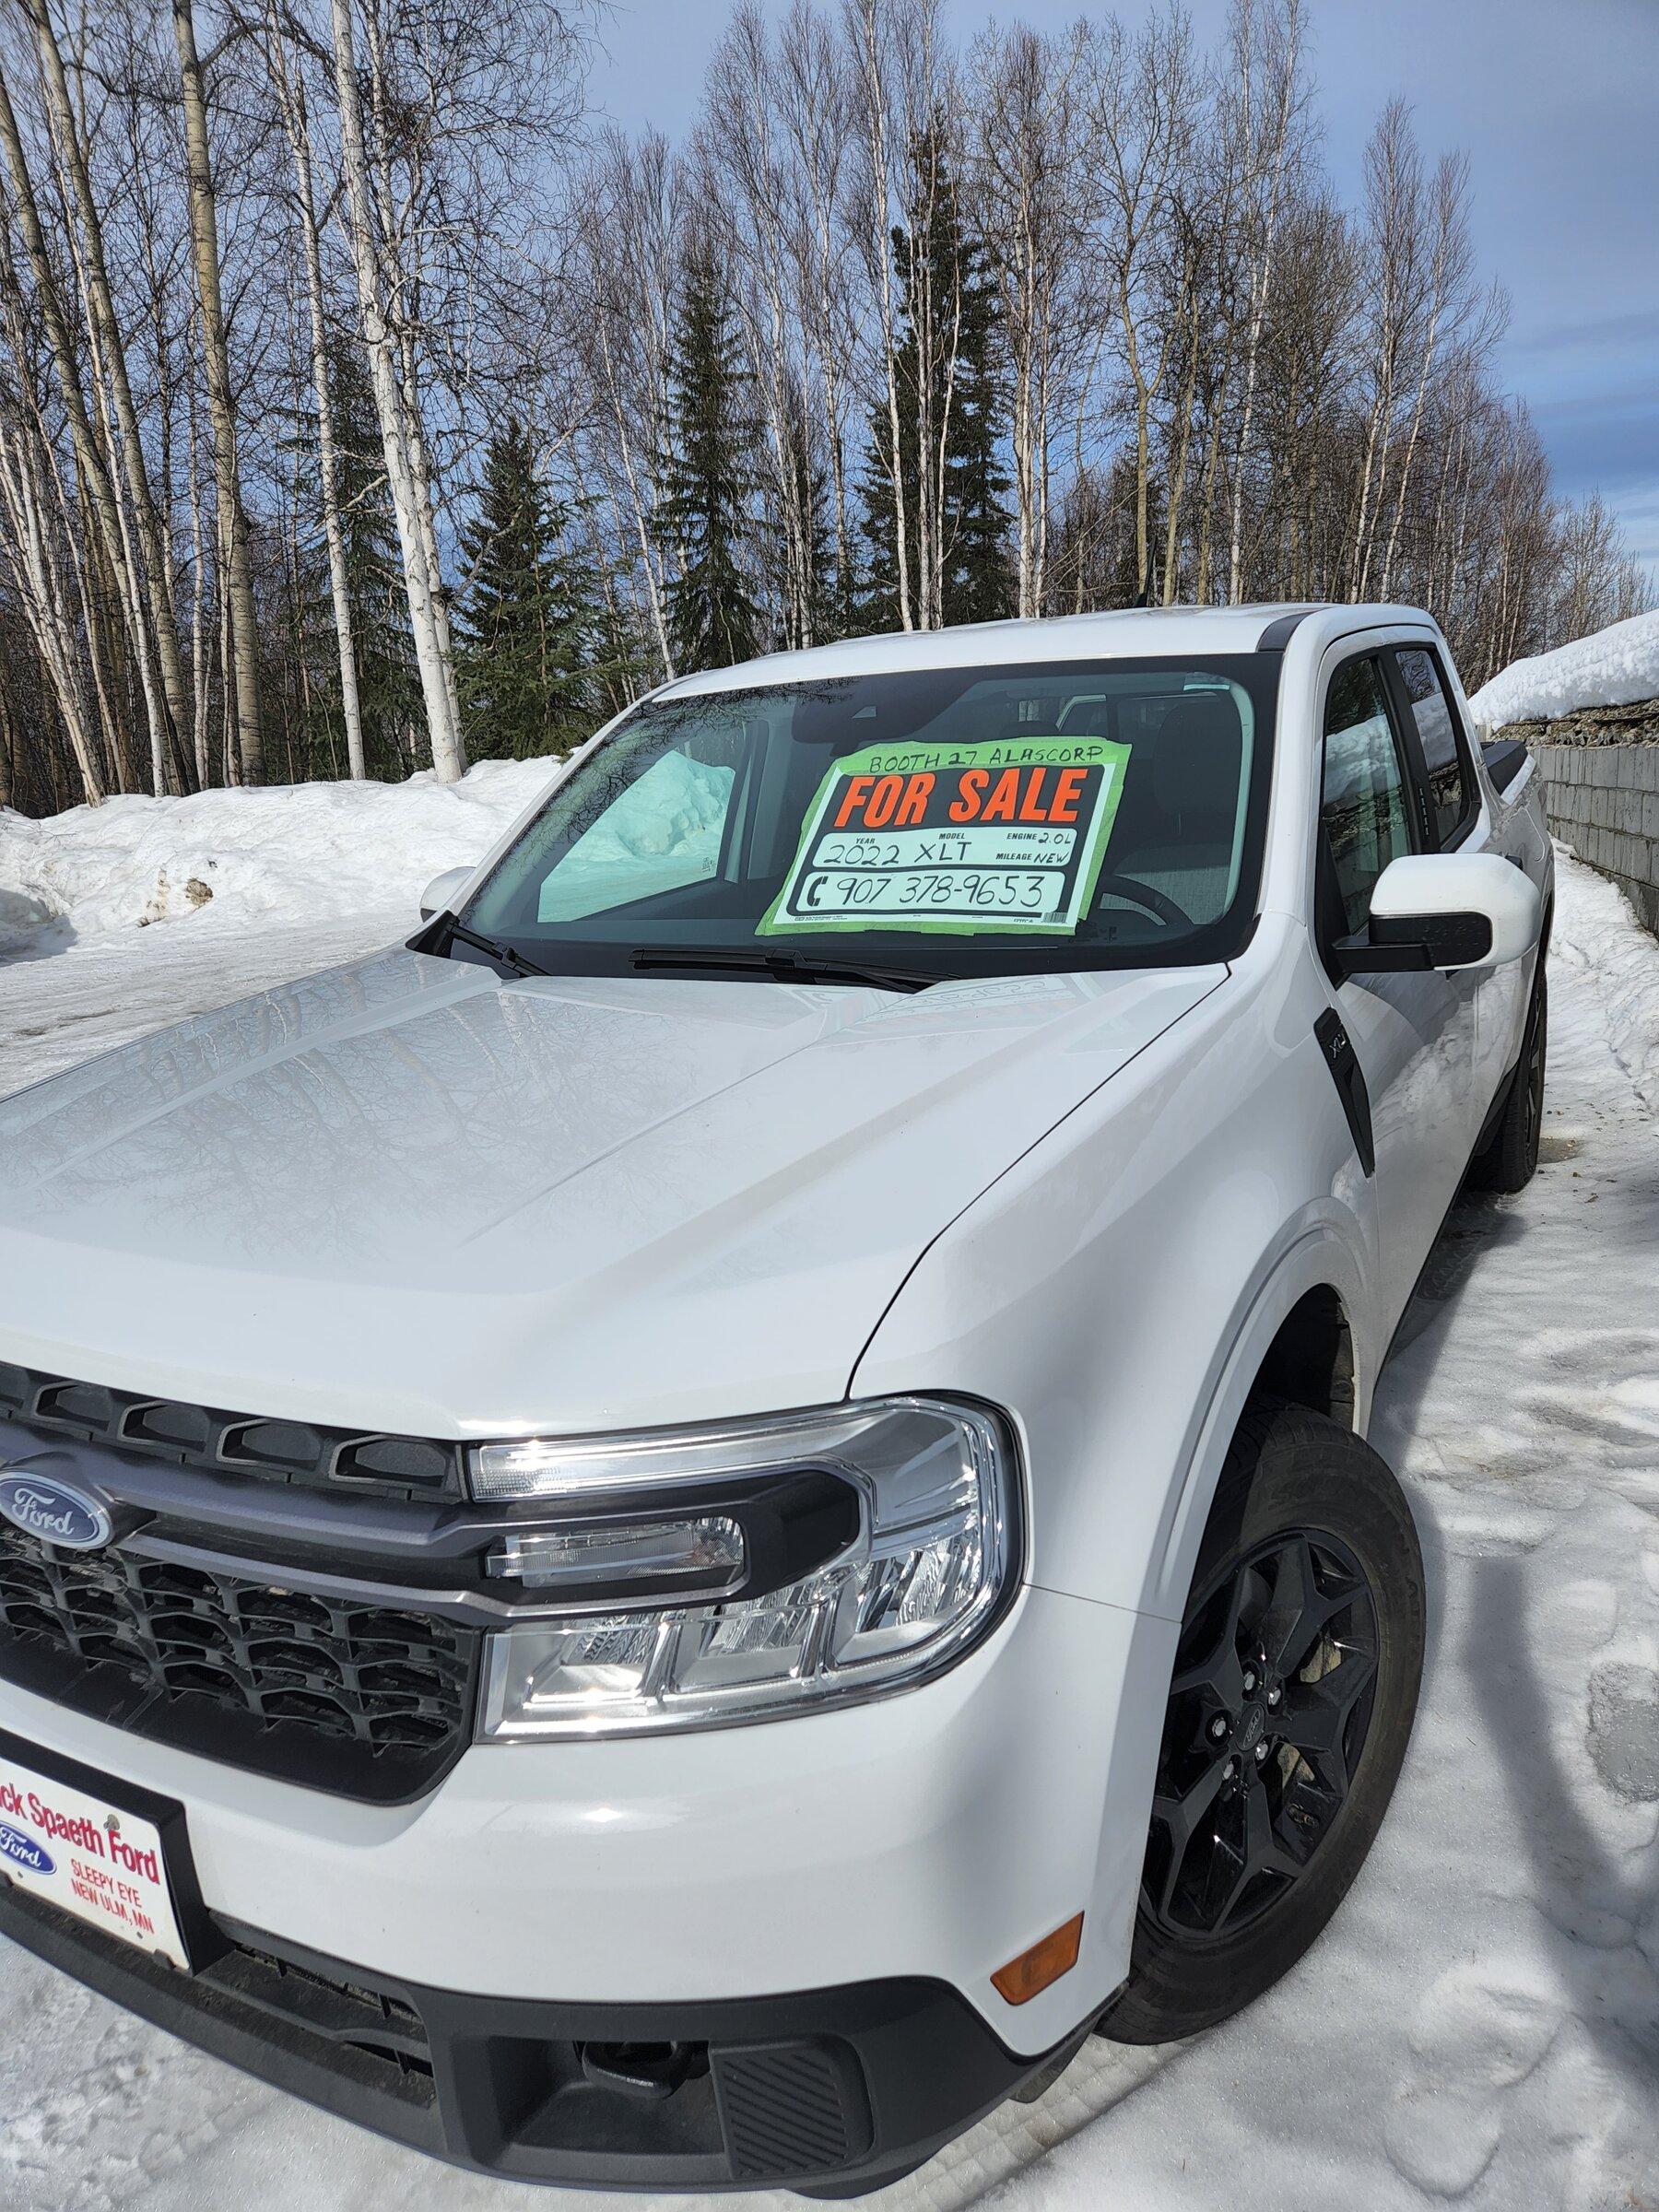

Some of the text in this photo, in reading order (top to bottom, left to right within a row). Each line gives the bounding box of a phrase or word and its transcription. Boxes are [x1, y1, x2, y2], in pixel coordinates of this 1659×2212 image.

[869, 754, 940, 773] BOOTH
[947, 751, 978, 766] 27
[833, 767, 1088, 828] FOR SALE
[1006, 832, 1037, 841] ENGINE
[1038, 832, 1071, 844] 2.0L
[823, 844, 900, 865] 2022
[914, 841, 972, 863] XLT
[995, 853, 1032, 861] MILEAGE
[1033, 852, 1069, 864] NEW
[837, 875, 1045, 907] 907 378-9653
[11, 1488, 76, 1535] Ford
[0, 1826, 42, 1868] Ford
[28, 1792, 105, 1858] Spaeth
[108, 1830, 160, 1885] Ford
[70, 1857, 142, 1908] SLEEPY EYE
[71, 1878, 98, 1906] NEW
[131, 1908, 155, 1935] MN
